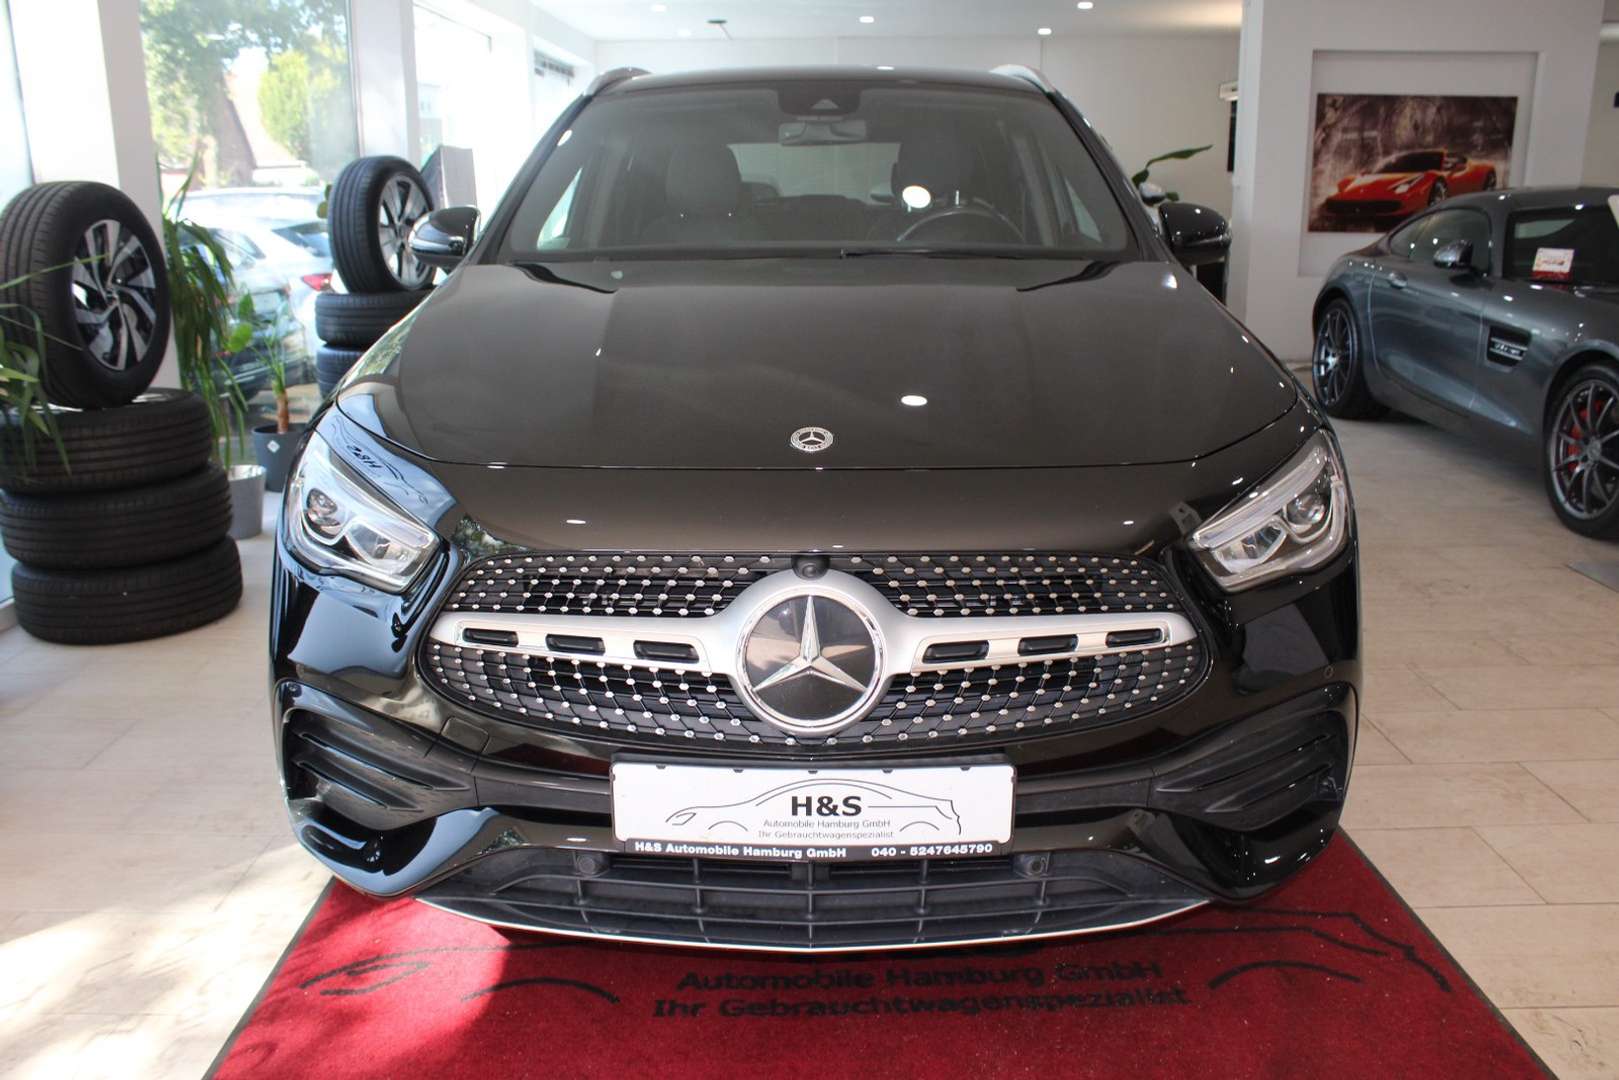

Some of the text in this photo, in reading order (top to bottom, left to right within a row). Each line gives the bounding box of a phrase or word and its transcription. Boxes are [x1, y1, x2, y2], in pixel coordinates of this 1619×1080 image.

[791, 795, 862, 817] H&S
[763, 819, 891, 829] Automobile Hamburg GmbH
[758, 830, 894, 840] Ihr Gebrauchtwagenspezialist
[634, 841, 847, 859] H&S Automobile Hamburg GmbH
[871, 847, 897, 857] 040
[909, 843, 993, 856] 5247645790
[676, 960, 1163, 991] Automobile Hamburg GmbH
[653, 999, 707, 1018] Ihr
